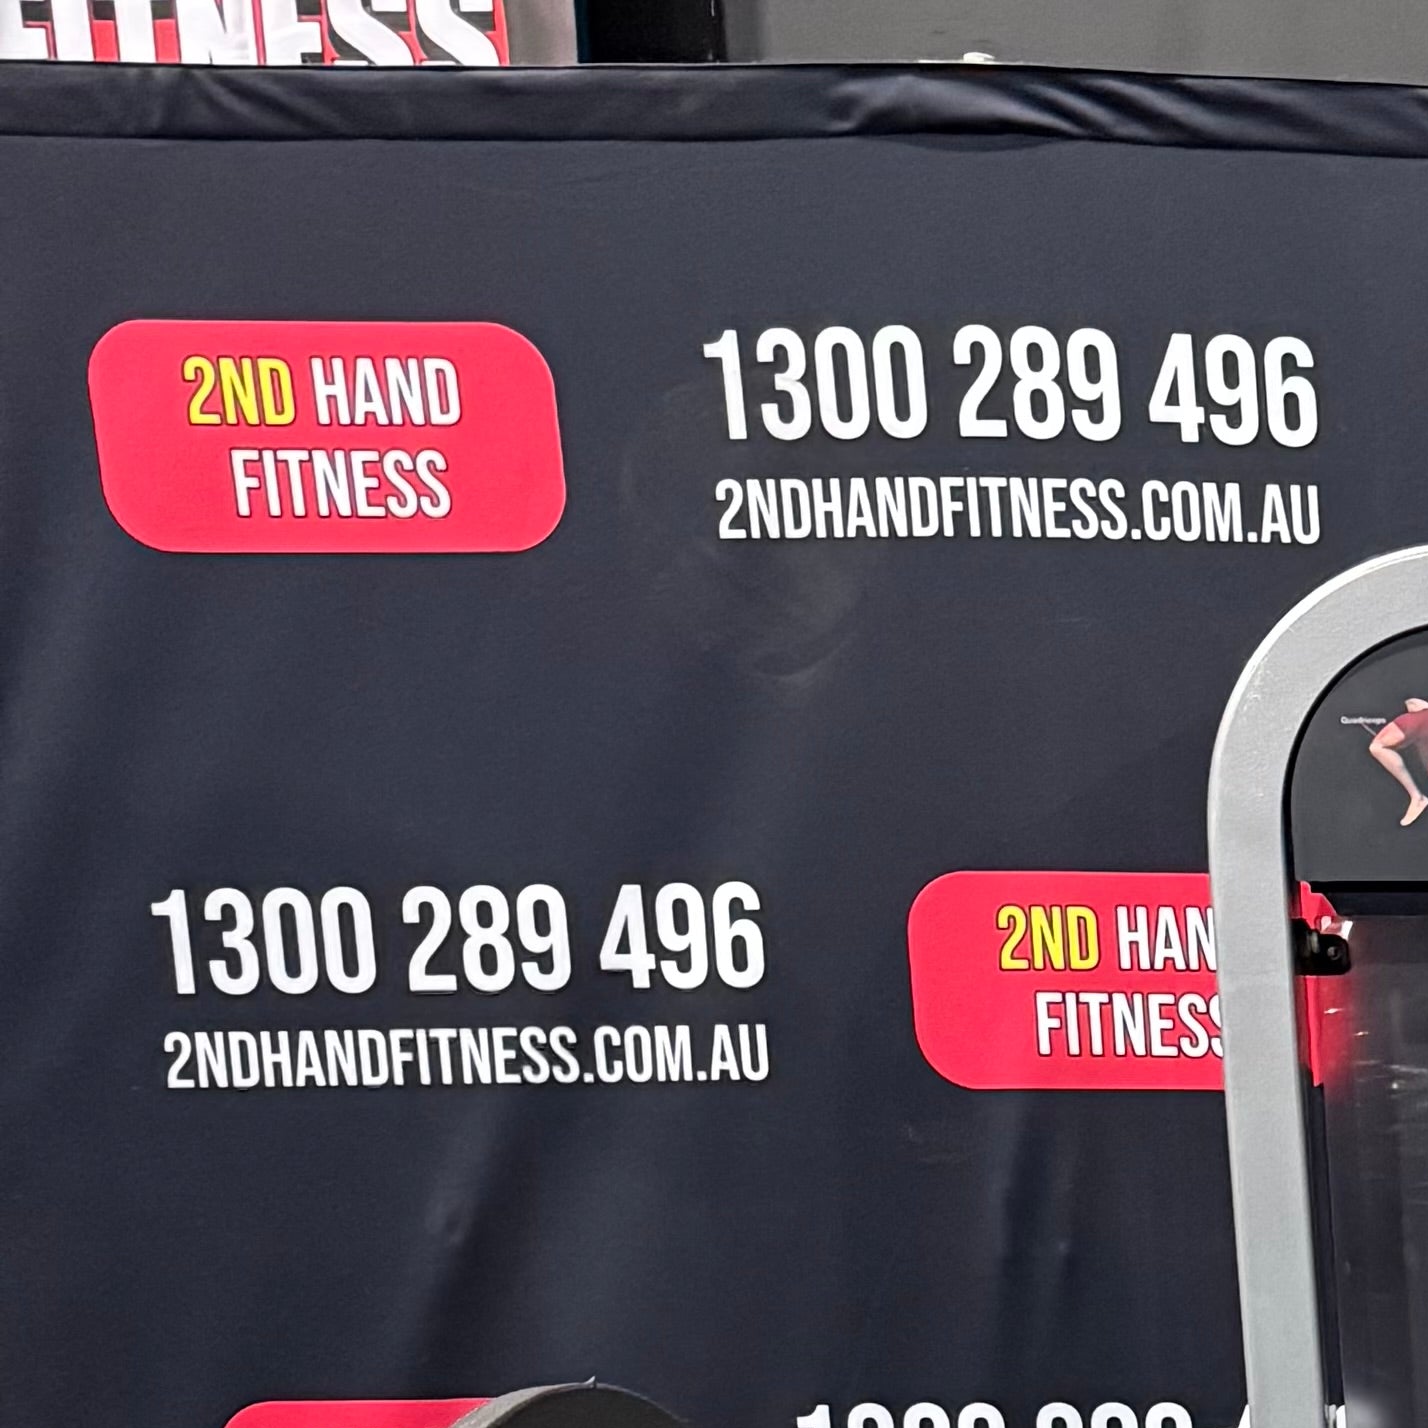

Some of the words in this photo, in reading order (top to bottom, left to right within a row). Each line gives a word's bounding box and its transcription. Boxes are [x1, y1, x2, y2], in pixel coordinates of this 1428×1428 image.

[184, 357, 294, 424] 2ND
[312, 358, 460, 424] HAND
[704, 325, 927, 440] 1300
[954, 325, 1121, 441] 289
[1149, 333, 1317, 447] 496
[232, 450, 450, 517] FITNESS
[716, 477, 1319, 544] 2NDHANDFITNESS.COM.AU
[151, 887, 376, 994] 1300
[403, 884, 571, 991] 289
[600, 881, 764, 989] 496
[999, 906, 1098, 969] 2ND
[1117, 906, 1216, 969] HAN
[164, 1024, 768, 1088] 2NDHANDFITNESS.COM.AU
